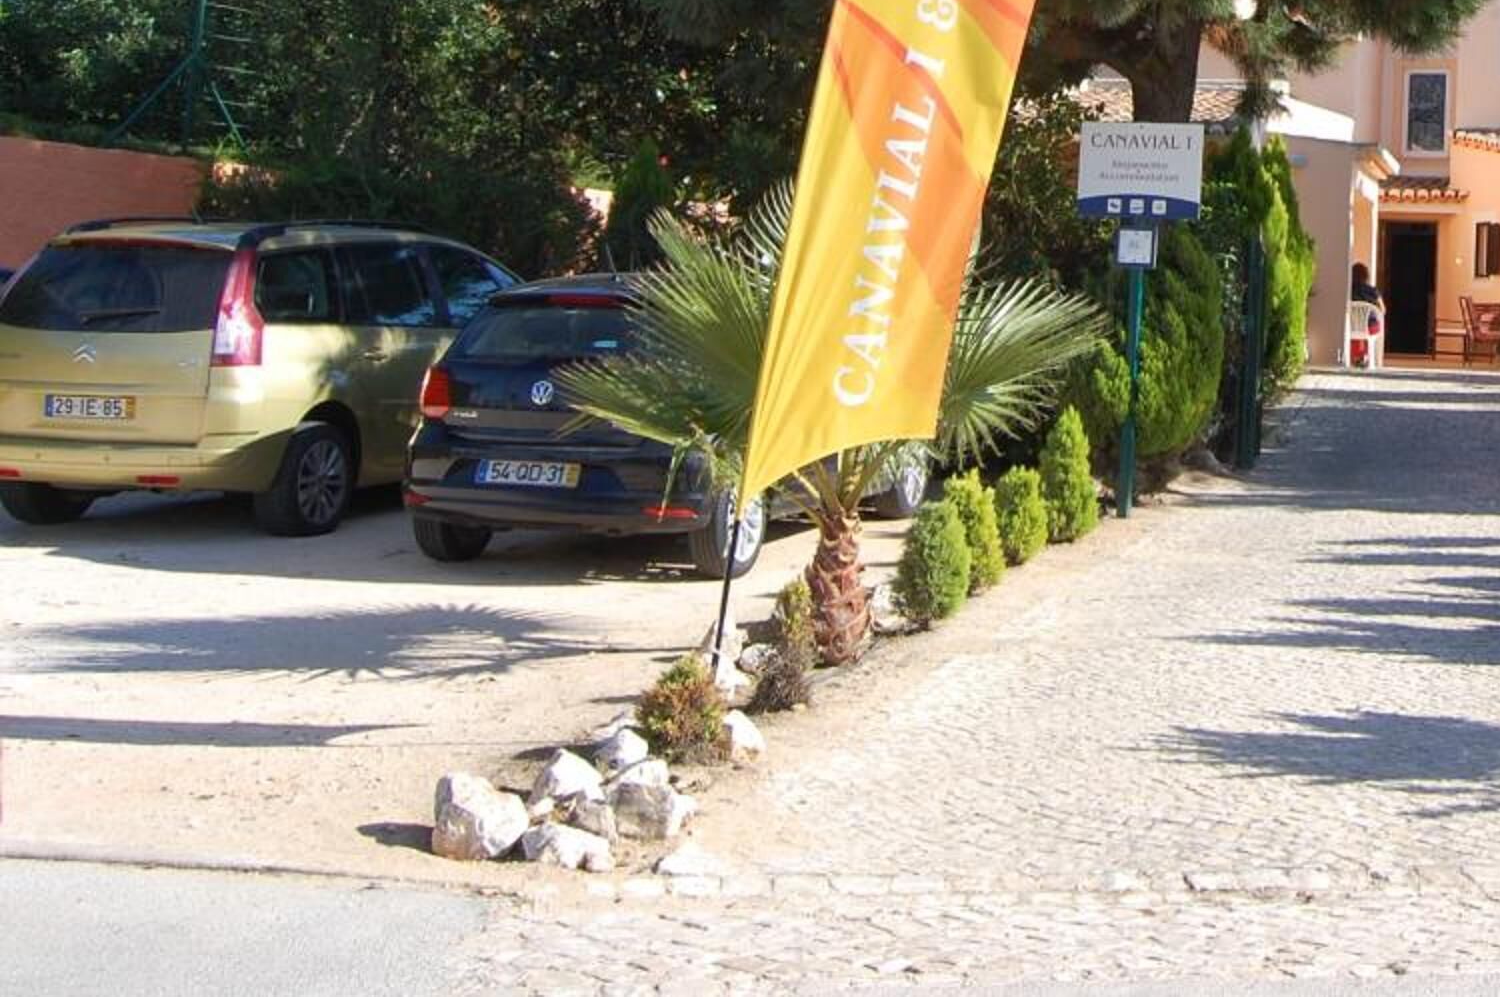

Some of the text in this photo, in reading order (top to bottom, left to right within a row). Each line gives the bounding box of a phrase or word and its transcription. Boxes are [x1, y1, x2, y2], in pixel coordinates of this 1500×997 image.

[832, 95, 937, 407] CANAVIAL
[904, 46, 945, 78] I
[1091, 133, 1180, 150] CANAVIAL
